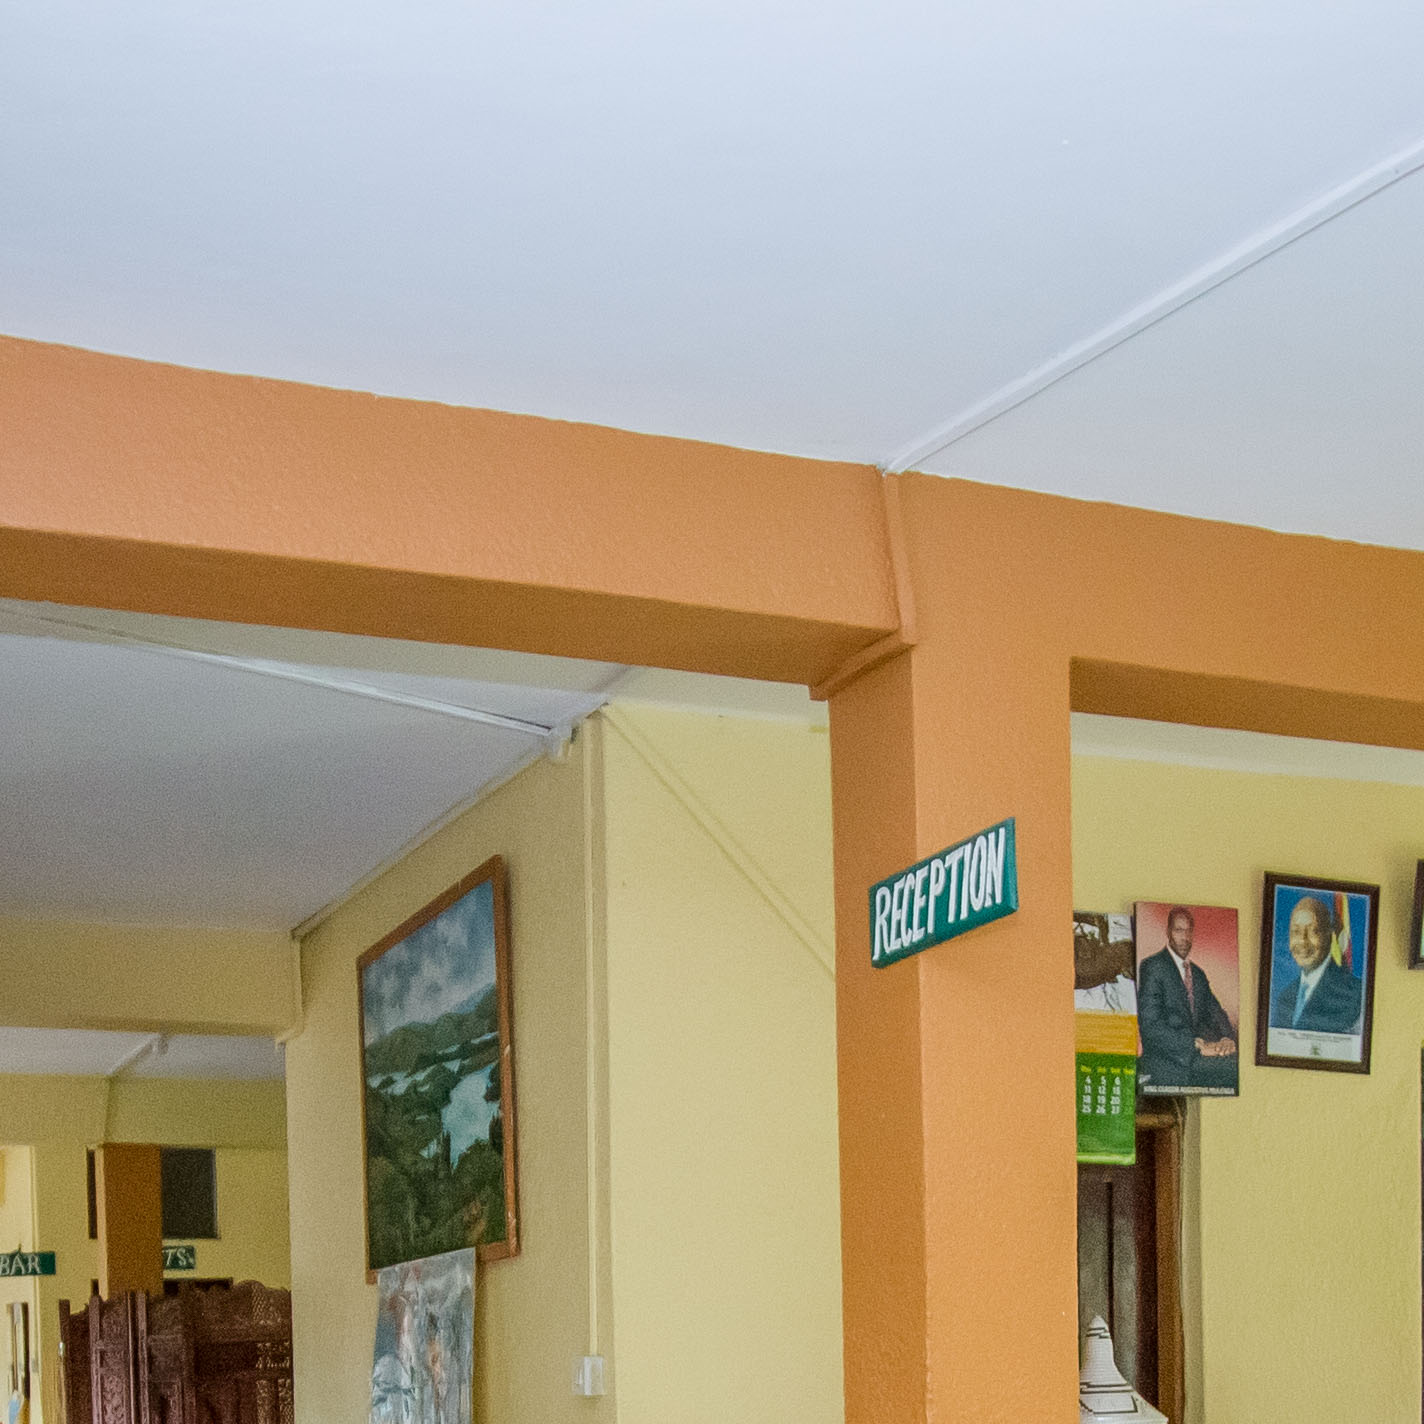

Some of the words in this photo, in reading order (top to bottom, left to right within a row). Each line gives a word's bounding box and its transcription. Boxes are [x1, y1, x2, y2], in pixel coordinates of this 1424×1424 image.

[872, 827, 1006, 961] RECEPTION
[1085, 1075, 1091, 1084] 4
[162, 1247, 187, 1266] TS
